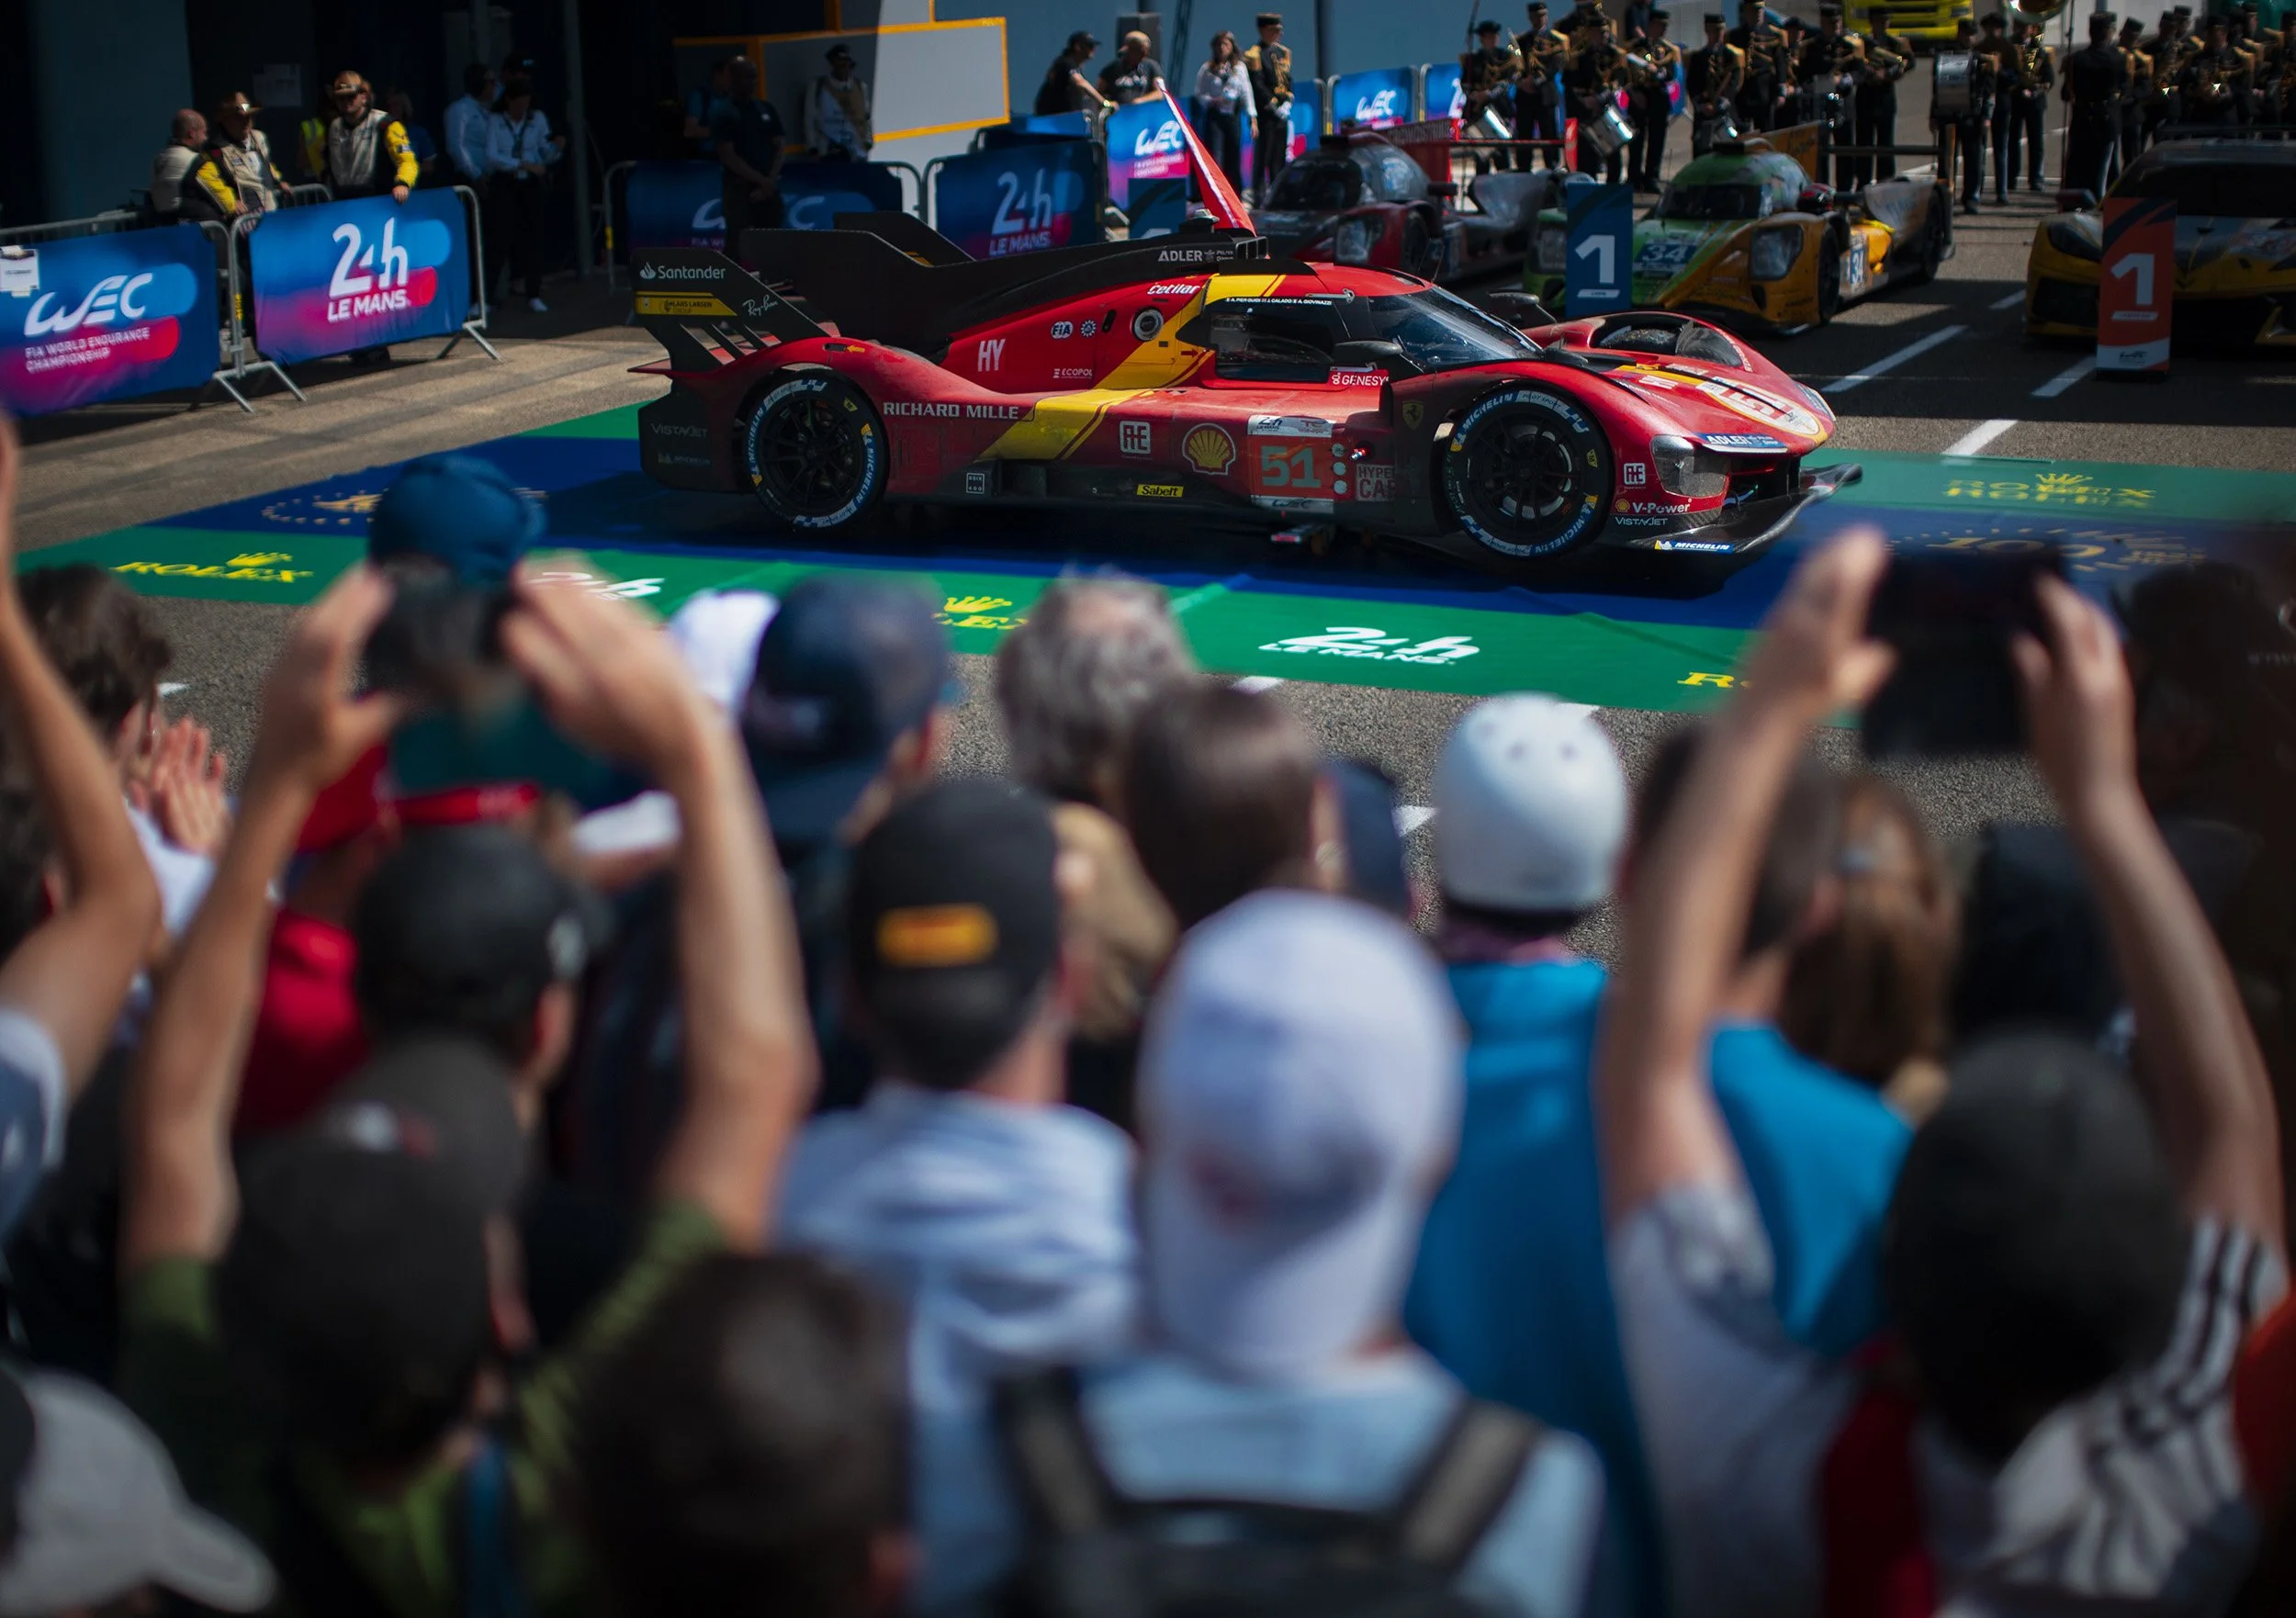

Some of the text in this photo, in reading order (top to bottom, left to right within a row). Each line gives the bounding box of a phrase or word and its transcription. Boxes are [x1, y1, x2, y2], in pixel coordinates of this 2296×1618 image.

[1355, 90, 1397, 120] WEC
[1134, 119, 1185, 156] WEC
[991, 168, 1052, 235] 24h
[329, 217, 409, 299] 24h
[989, 230, 1052, 256] LE MANS
[1157, 250, 1202, 262] ADLER
[1574, 234, 1615, 285] 1
[1642, 244, 1687, 263] 34
[658, 265, 726, 279] Santander
[1851, 251, 1864, 284] 34
[2110, 252, 2155, 306] 1
[24, 272, 153, 337] WEC
[327, 289, 408, 323] LE MANS
[742, 295, 779, 316] Ray-Ban
[25, 327, 151, 360] FIA WORLD ENDURANCE
[977, 338, 1007, 372] HY
[26, 347, 111, 374] CHAMPIONSHIP
[1061, 368, 1093, 376] ECOPOL
[883, 402, 1019, 420] RICHARD MILLE
[1462, 392, 1515, 433] MICHELIN
[747, 408, 764, 463] MICHELIN
[1706, 435, 1752, 445] ADLER
[855, 447, 875, 503] MICHELIN
[1260, 445, 1322, 489] 51
[1358, 466, 1395, 479] HYPE
[1141, 484, 1179, 497] Sabelt
[1632, 502, 1691, 514] V-Power
[1534, 517, 1586, 554] MICHELIN
[1673, 542, 1730, 550] MICHELIN
[1277, 626, 1480, 659] 24h
